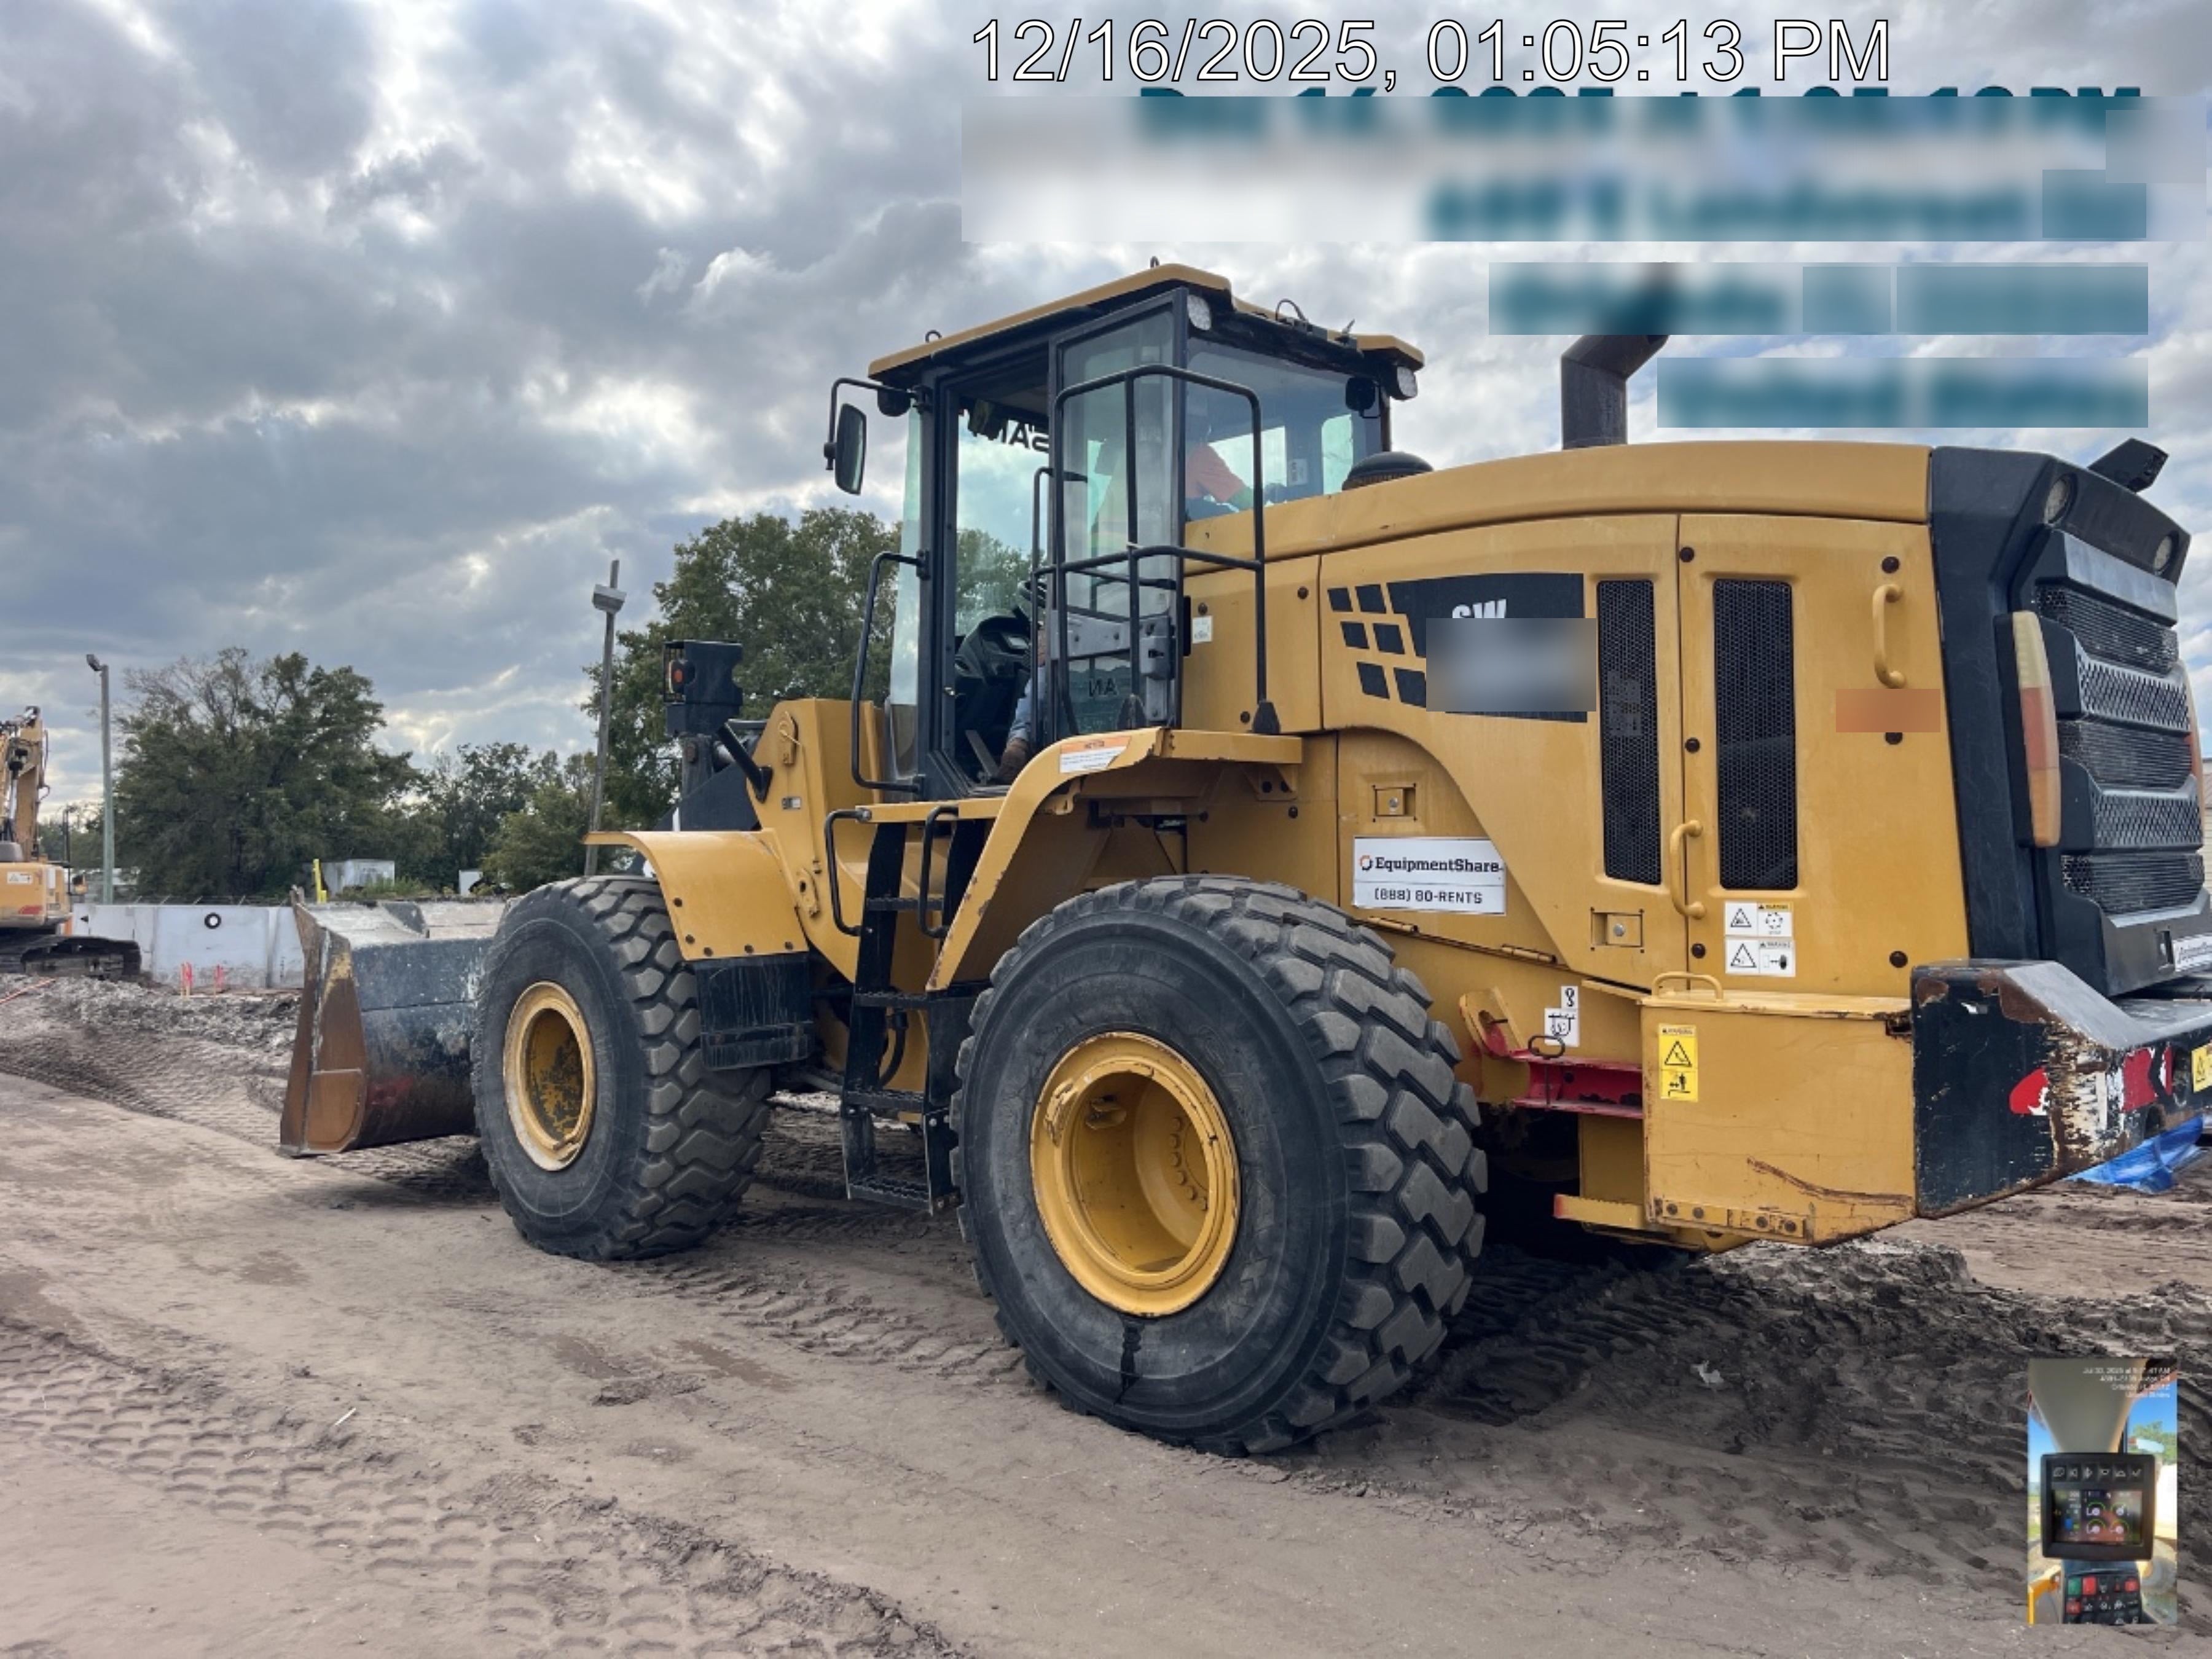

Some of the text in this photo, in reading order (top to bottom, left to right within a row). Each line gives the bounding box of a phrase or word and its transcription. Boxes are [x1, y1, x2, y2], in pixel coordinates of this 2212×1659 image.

[1376, 857, 1500, 873] EquipmentShare
[1375, 888, 1483, 904] (888) 80-RENTS
